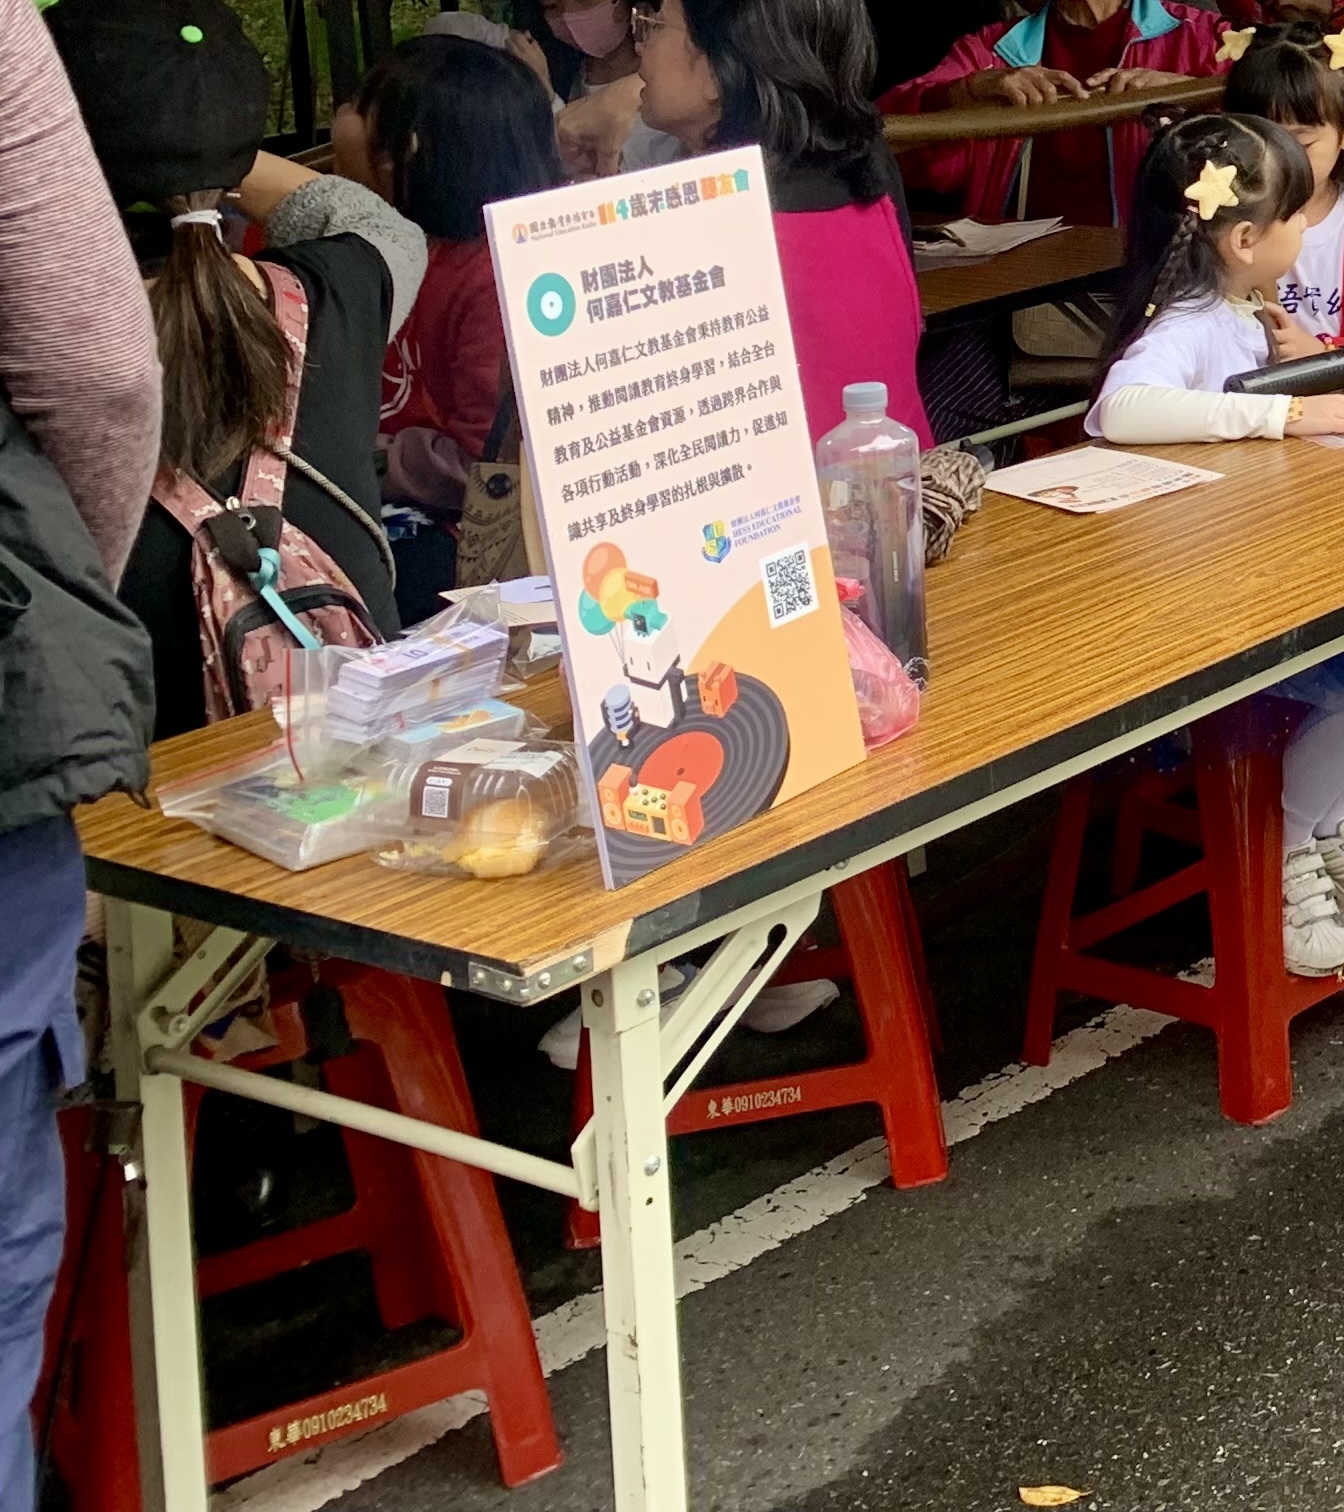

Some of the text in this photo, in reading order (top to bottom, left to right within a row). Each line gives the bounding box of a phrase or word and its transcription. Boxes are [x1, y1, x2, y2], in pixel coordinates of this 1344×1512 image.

[580, 254, 654, 295] 財團法人
[586, 264, 727, 324] 何嘉仁文教基金會
[540, 304, 770, 388] 財團法人何嘉仁文教基金會秉持教育公益
[734, 524, 781, 548] FOUNDATION
[752, 505, 802, 531] EDUCATIONAL
[706, 1085, 802, 1120] 東華0910234734
